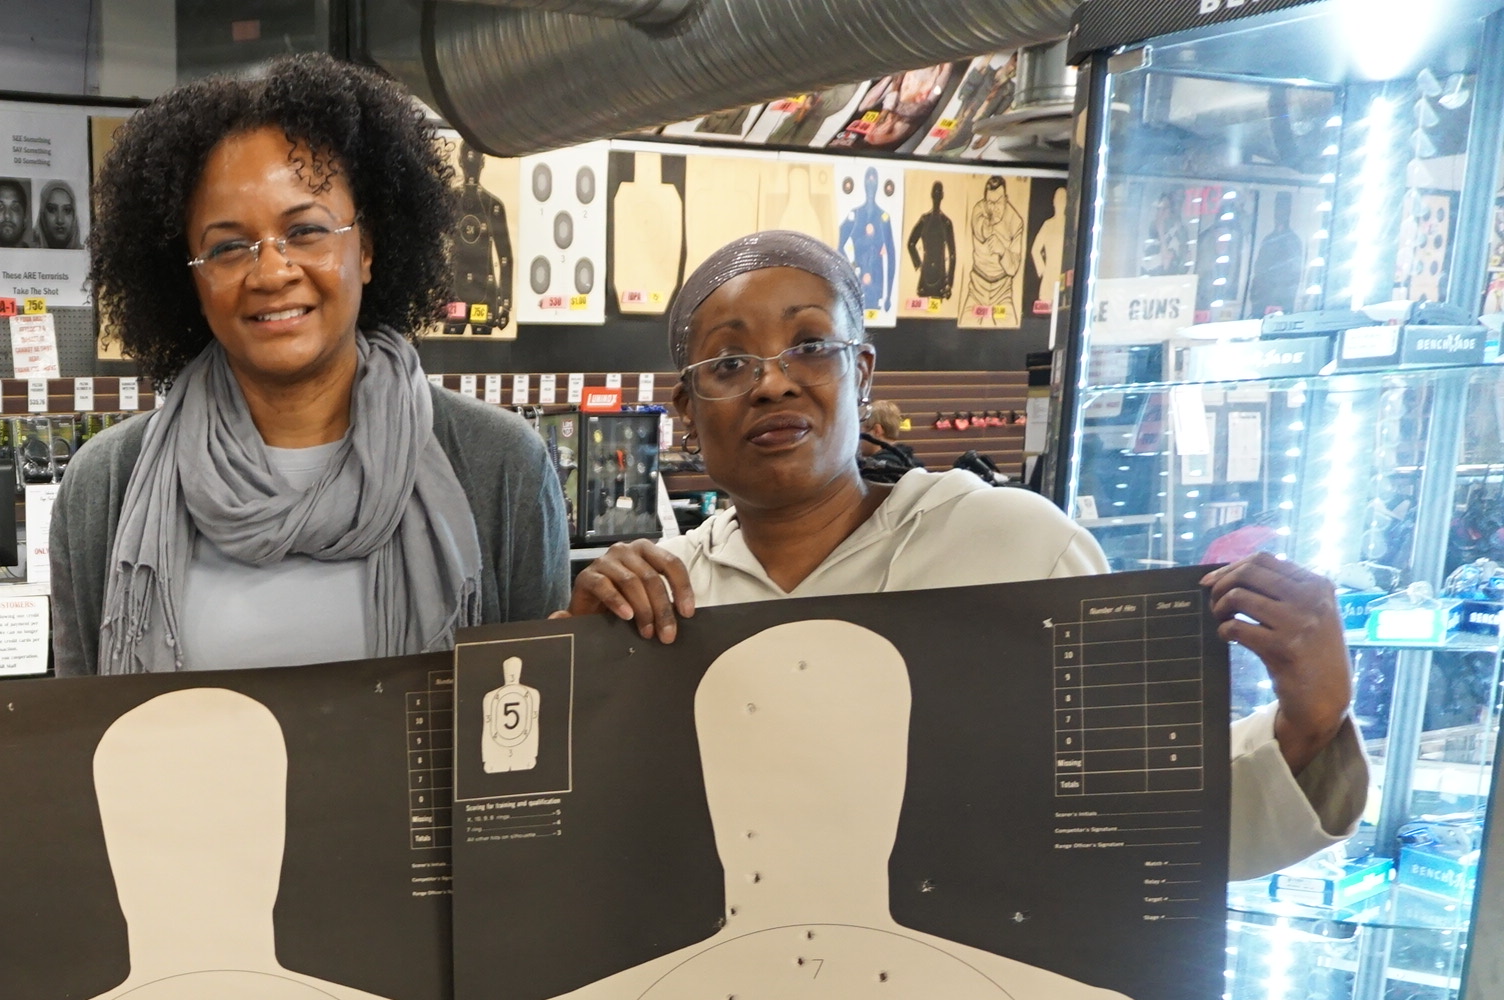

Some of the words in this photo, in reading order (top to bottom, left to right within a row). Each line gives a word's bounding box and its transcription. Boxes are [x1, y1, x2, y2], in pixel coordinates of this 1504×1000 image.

[23, 136, 51, 145] Something
[23, 147, 51, 155] Something
[23, 158, 50, 166] Something
[2, 271, 21, 280] These
[23, 272, 36, 280] ARE
[38, 272, 69, 280] Terrorists
[13, 287, 29, 295] Take
[30, 287, 42, 295] The
[43, 287, 58, 295] Shot
[1093, 301, 1108, 322] E
[1129, 298, 1180, 320] GUNS
[1416, 334, 1476, 353] BENCHMADE
[504, 702, 520, 730] 5
[1057, 759, 1081, 767] Missing
[465, 804, 485, 812] Scoring
[495, 801, 515, 809] training
[528, 798, 561, 807] qualification
[811, 958, 825, 980] 7
